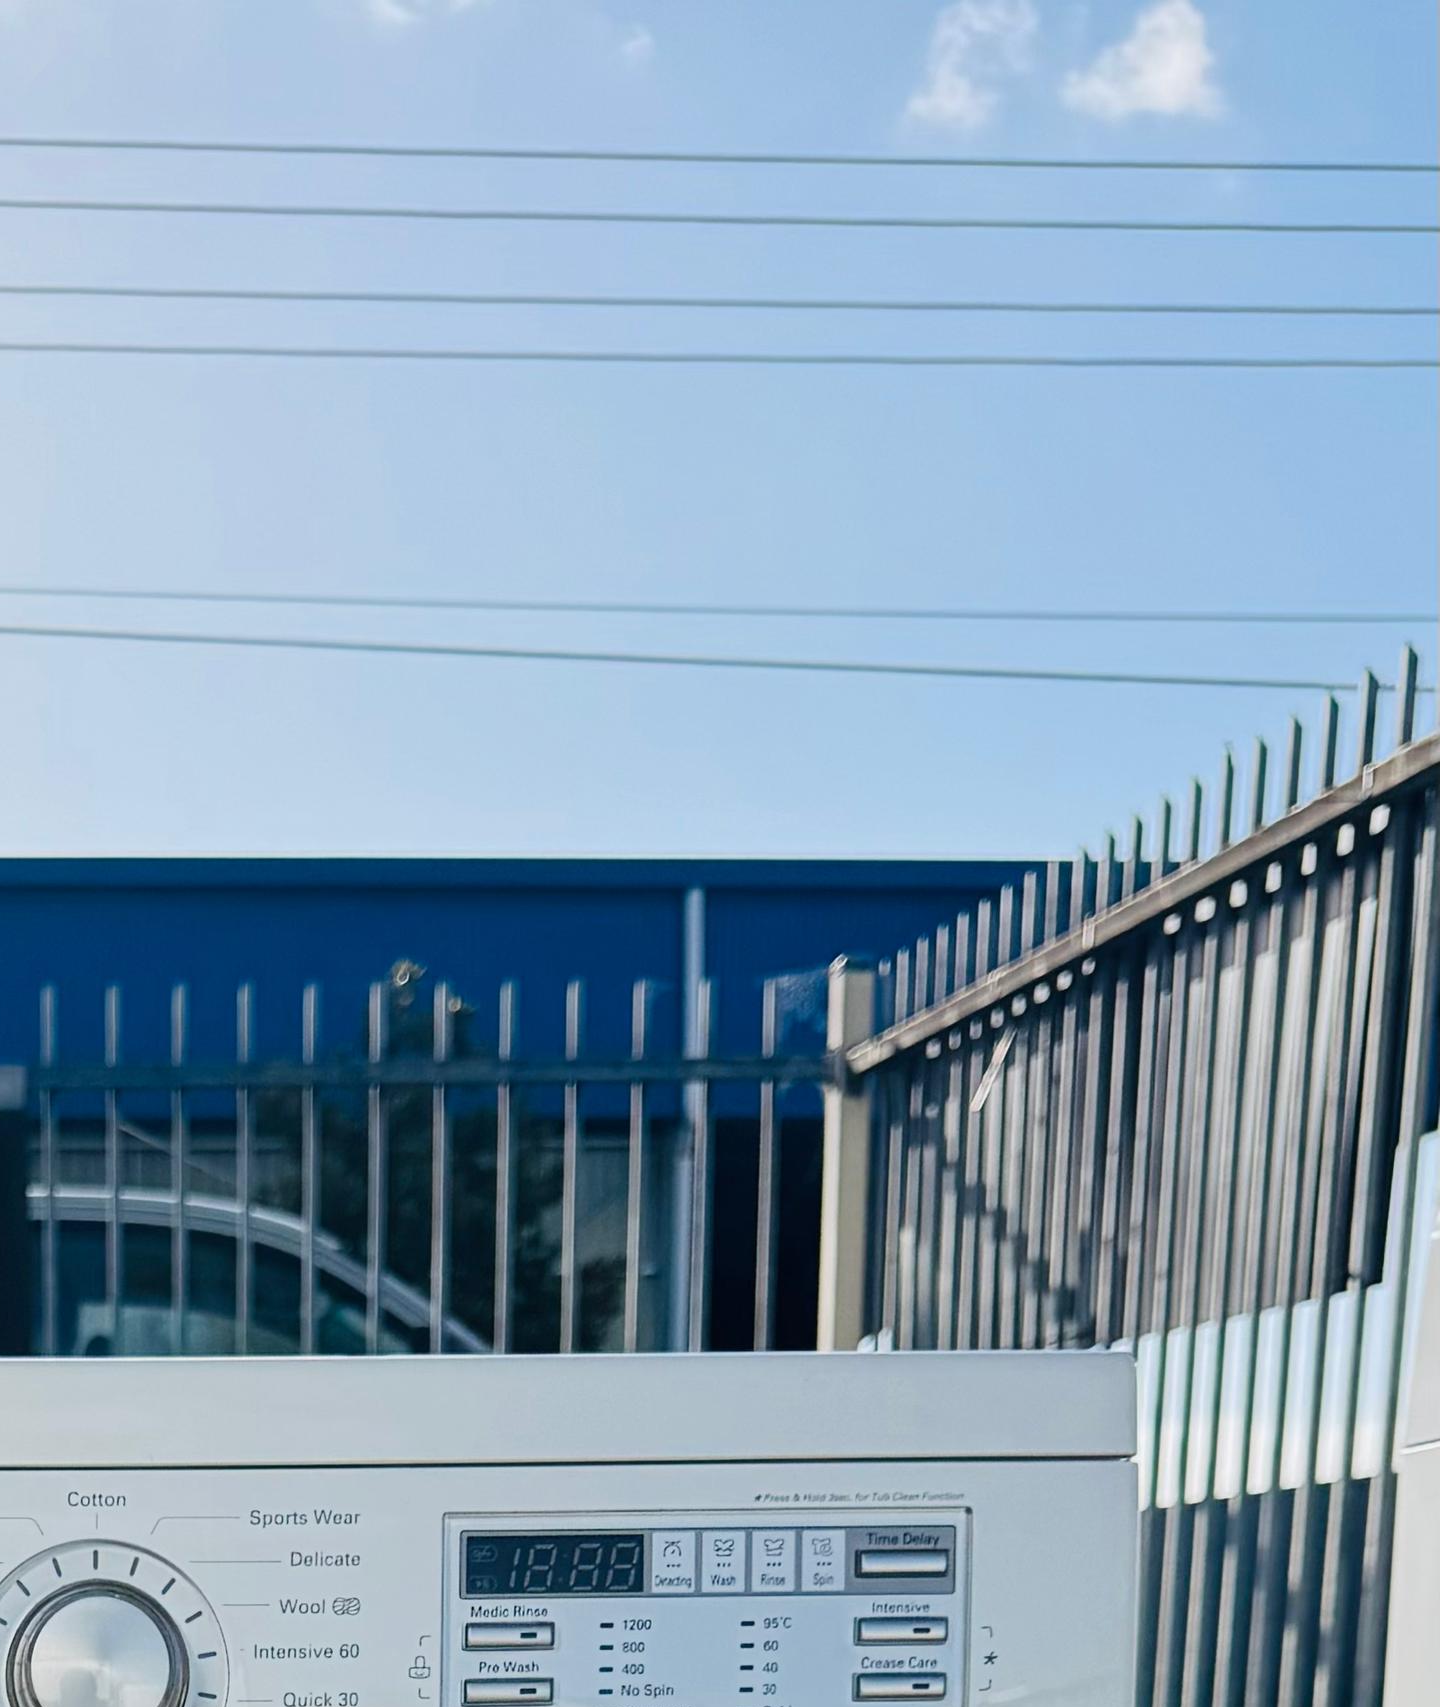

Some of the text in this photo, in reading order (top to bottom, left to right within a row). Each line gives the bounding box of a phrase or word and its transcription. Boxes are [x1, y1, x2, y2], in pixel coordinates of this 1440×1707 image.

[67, 1492, 126, 1507] Cotton
[249, 1509, 361, 1528] Sports Wear
[867, 1533, 940, 1546] Time Delay
[290, 1552, 361, 1567] Delicate
[711, 1575, 736, 1586] Wash
[761, 1574, 786, 1585] Rinse
[813, 1573, 833, 1586] Spin
[279, 1598, 325, 1615] Wool
[471, 1605, 548, 1617] Medic Rinse
[872, 1603, 930, 1613] Intensive
[622, 1620, 652, 1630] 1200
[254, 1644, 360, 1660] Intensive 60
[622, 1642, 645, 1652] 800
[763, 1641, 778, 1652] 60
[479, 1661, 539, 1673] Pre Wash
[622, 1664, 645, 1674] 400
[762, 1662, 778, 1673] 40
[861, 1657, 938, 1669] Crease Care
[621, 1685, 674, 1698] No Spin
[762, 1684, 776, 1695] 30
[339, 1693, 359, 1707] 30
